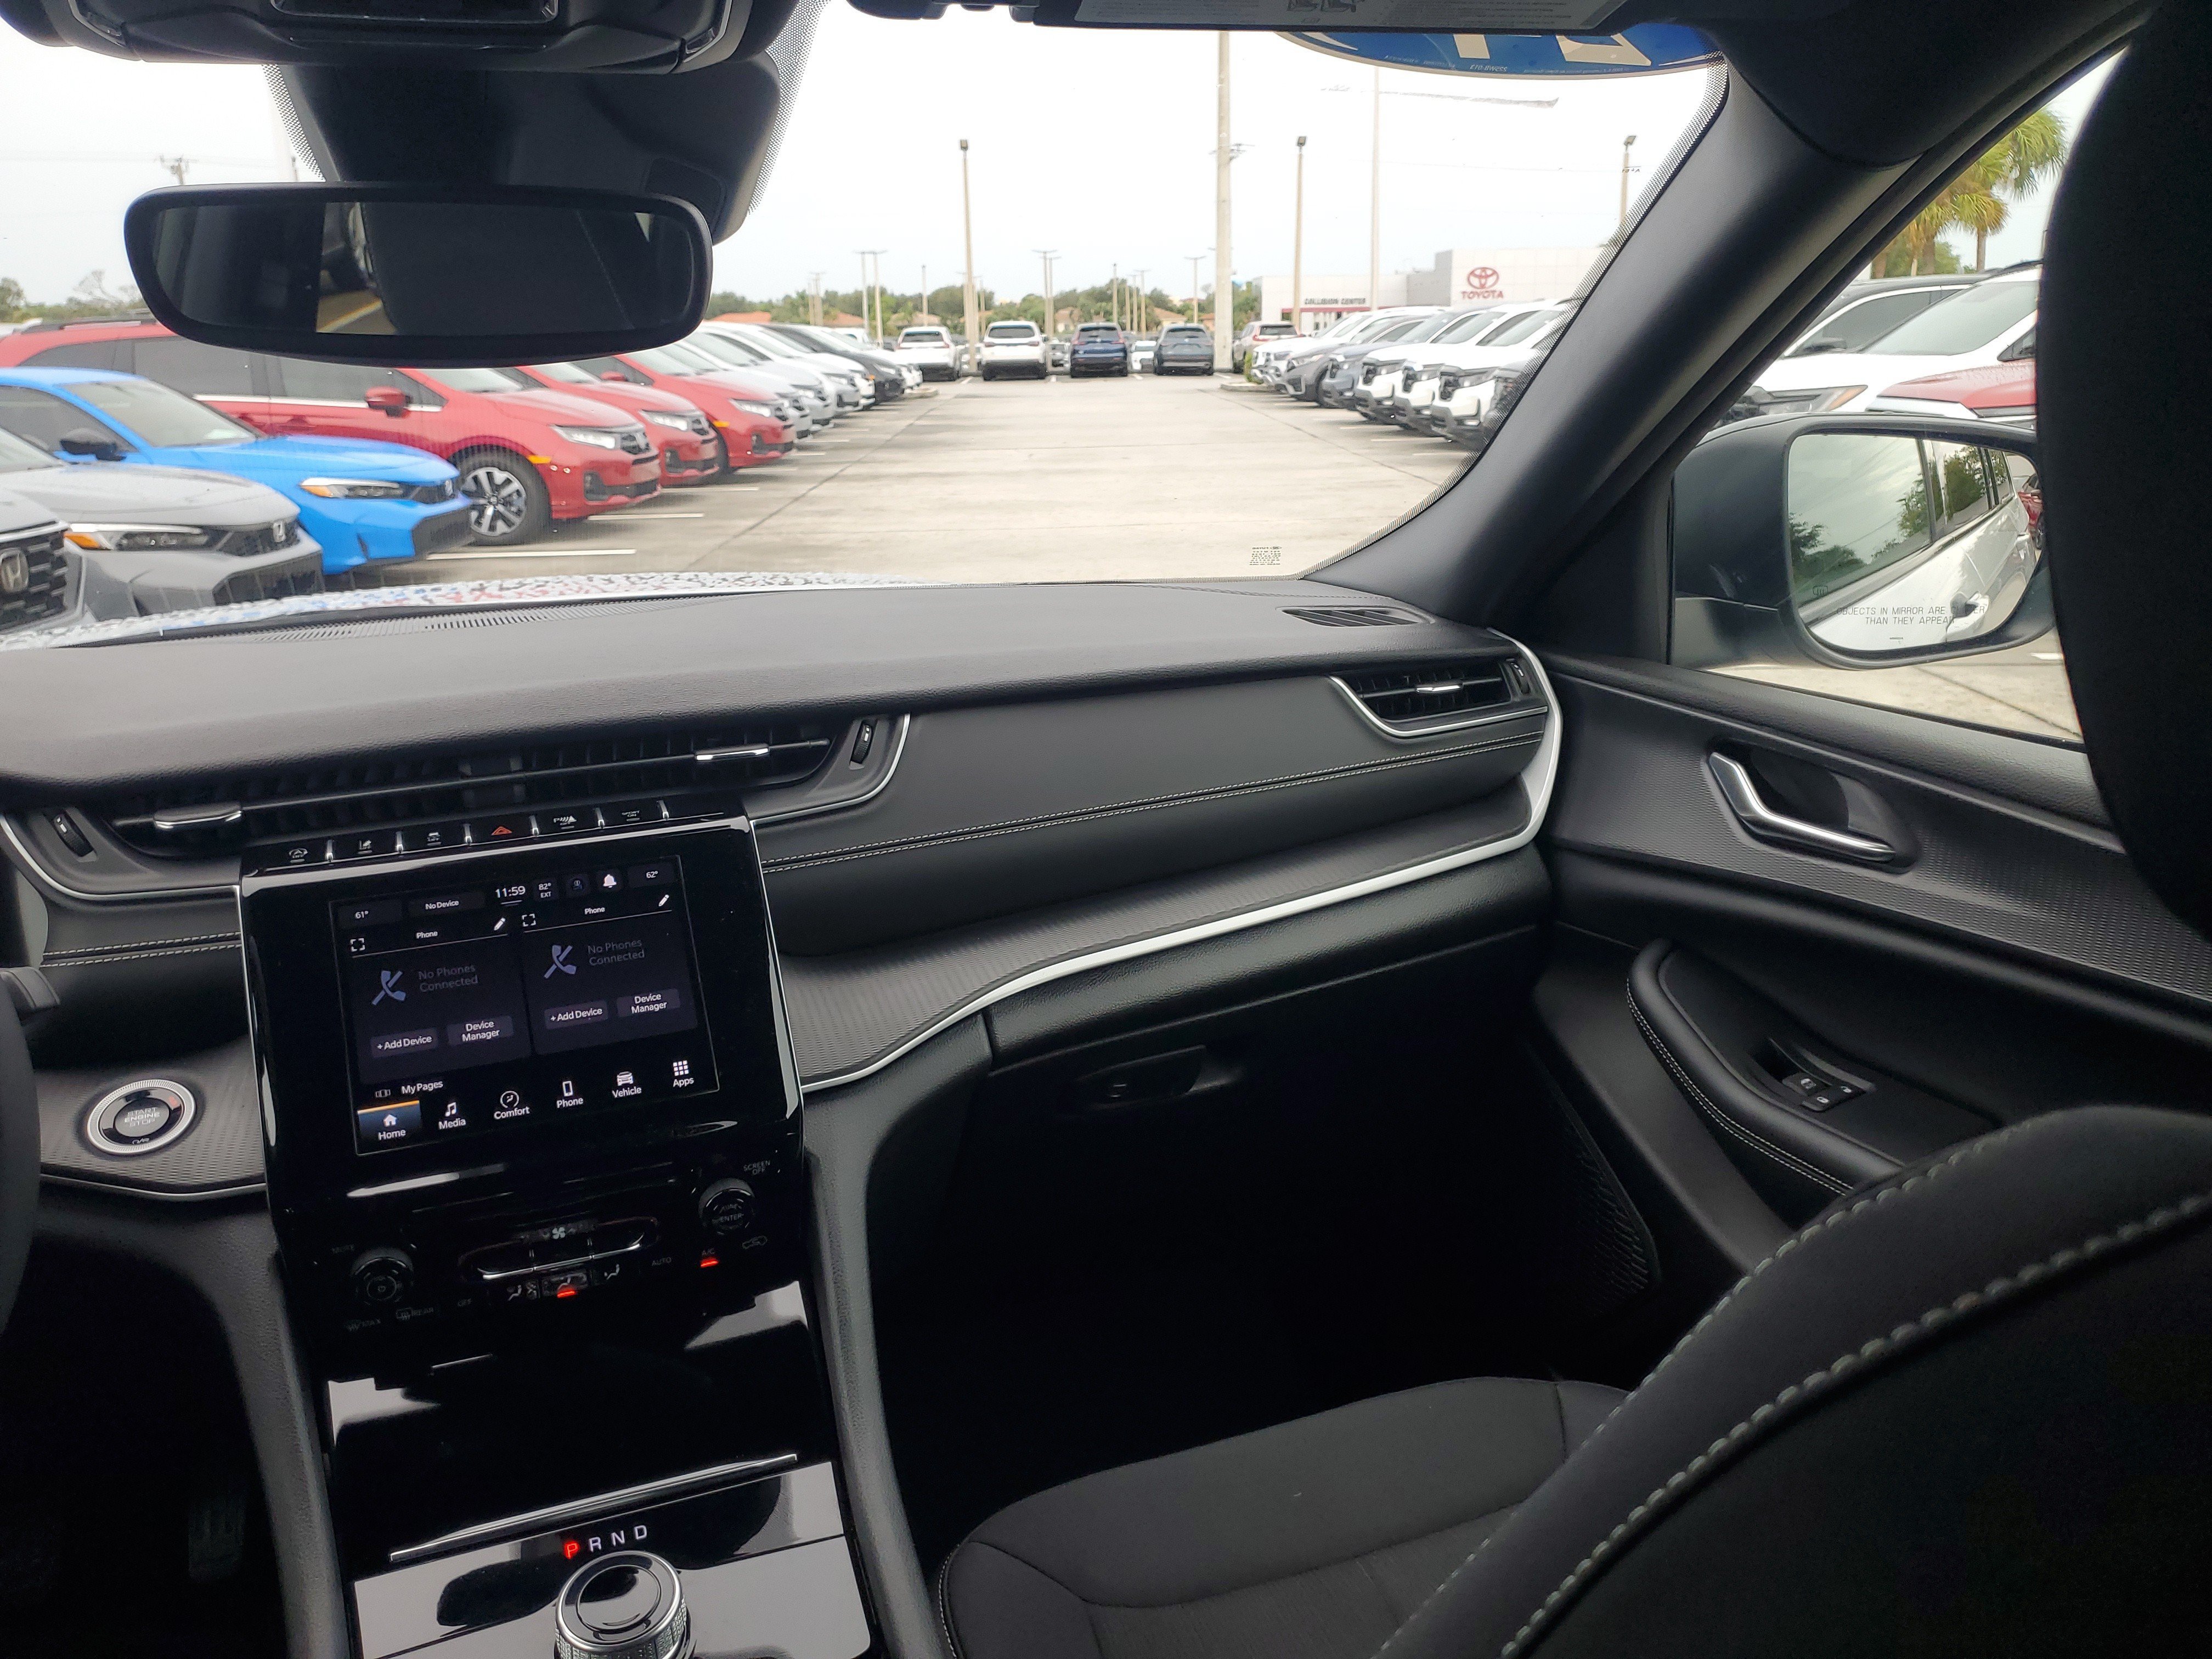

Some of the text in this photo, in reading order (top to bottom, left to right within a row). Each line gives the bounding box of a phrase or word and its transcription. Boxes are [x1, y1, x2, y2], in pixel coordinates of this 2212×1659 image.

[1460, 290, 1504, 300] TOYOTA
[1836, 607, 1876, 615] OBJECTS
[1880, 607, 1888, 615] IN
[1892, 606, 1924, 615] MIRROR
[1928, 606, 1946, 614] ARE
[1865, 616, 1955, 624] THAN THEY APPEAR
[646, 871, 658, 879] 62°
[495, 885, 526, 898] 11:59
[539, 882, 552, 890] 82°
[437, 899, 460, 909] Device
[584, 906, 605, 915] Phone
[416, 930, 438, 939] Phone
[588, 939, 642, 955] No Phones
[589, 949, 645, 966] Connected
[418, 965, 476, 980] No Phones
[419, 975, 479, 992] Connected
[634, 993, 662, 1005] Device
[575, 1007, 603, 1019] Device
[630, 1001, 668, 1014] Manager
[465, 1020, 495, 1032] Device
[403, 1035, 432, 1047] Device
[461, 1029, 500, 1042] Manager
[401, 1081, 444, 1095] My Pages
[673, 1077, 695, 1088] Apps
[611, 1086, 642, 1098] Vehicle
[556, 1097, 584, 1108] Phone
[493, 1106, 530, 1120] Comfort
[439, 1118, 466, 1130] Media
[378, 1128, 407, 1141] Home
[743, 1160, 771, 1172] SCREEN
[752, 1167, 765, 1176] OFF
[563, 1525, 648, 1559] P R N D
